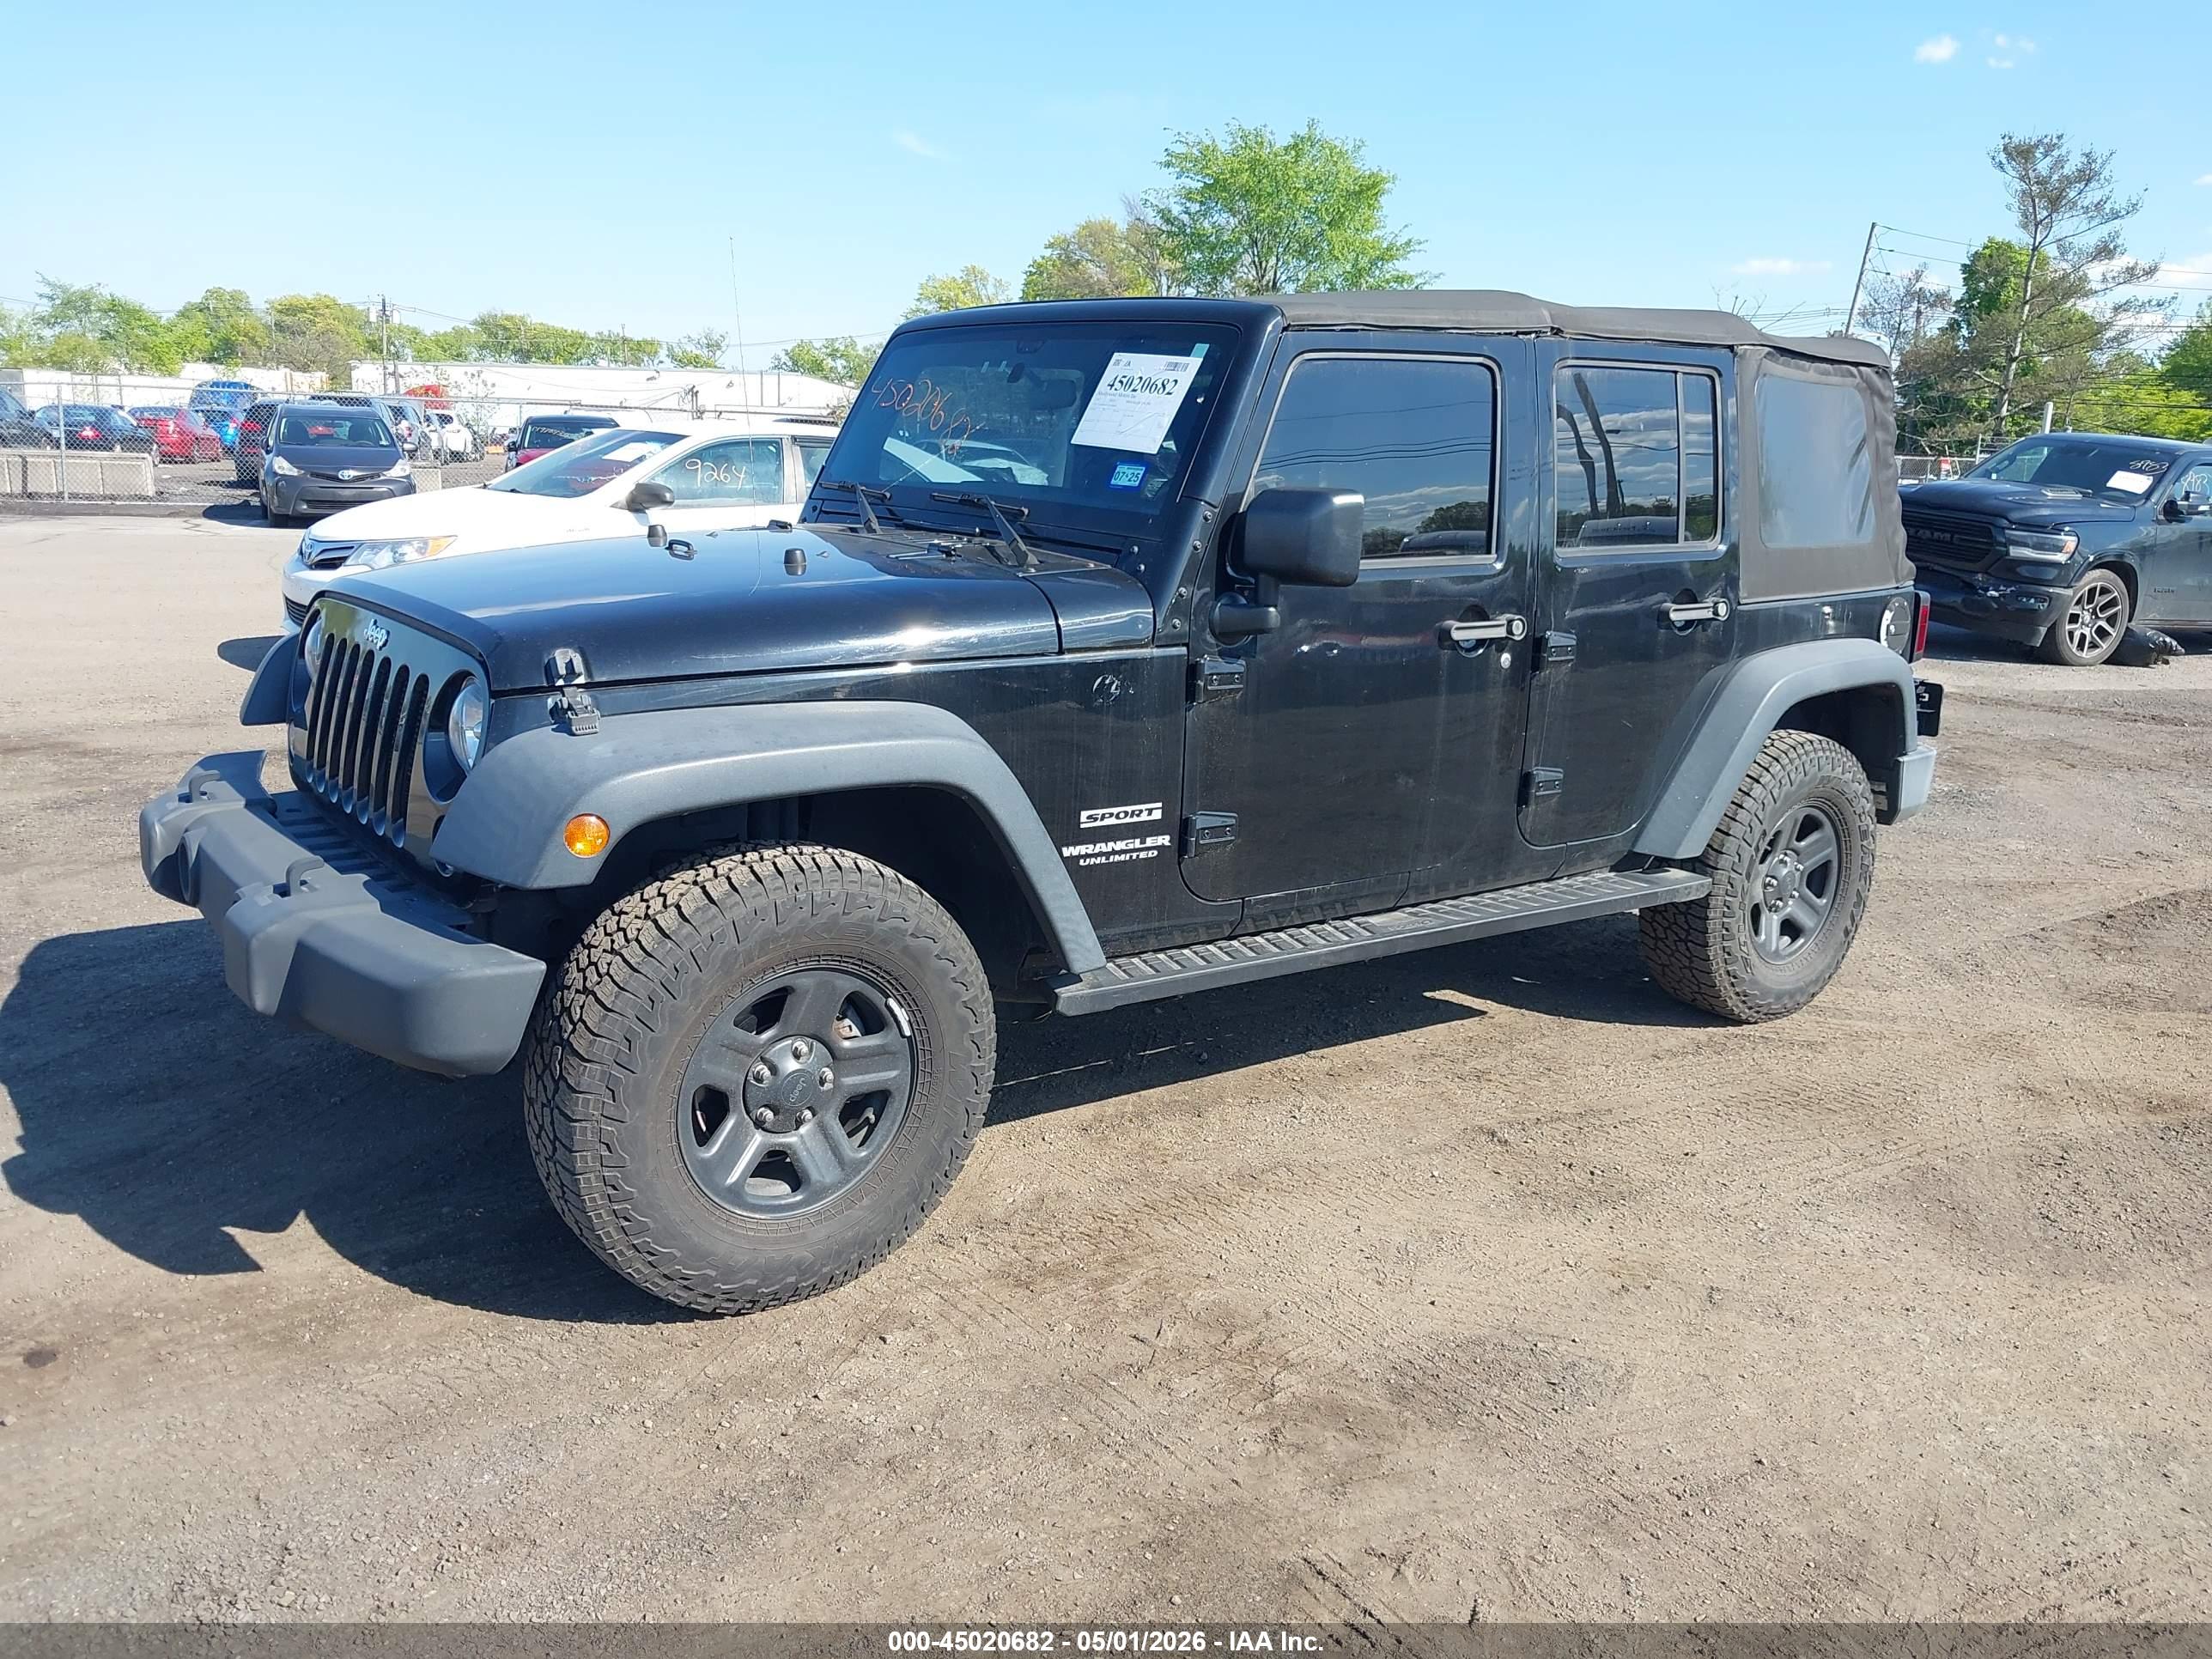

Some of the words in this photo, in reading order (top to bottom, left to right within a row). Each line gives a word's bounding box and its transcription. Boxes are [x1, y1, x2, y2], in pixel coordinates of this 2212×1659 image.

[1107, 374, 1179, 396] 45020682
[685, 459, 746, 491] 9264
[363, 617, 390, 651] Jeep
[1085, 807, 1158, 823] SPORT
[1061, 835, 1171, 858] WRANGLER
[1079, 850, 1158, 866] UNLIMITED
[789, 1078, 807, 1102] Jeep
